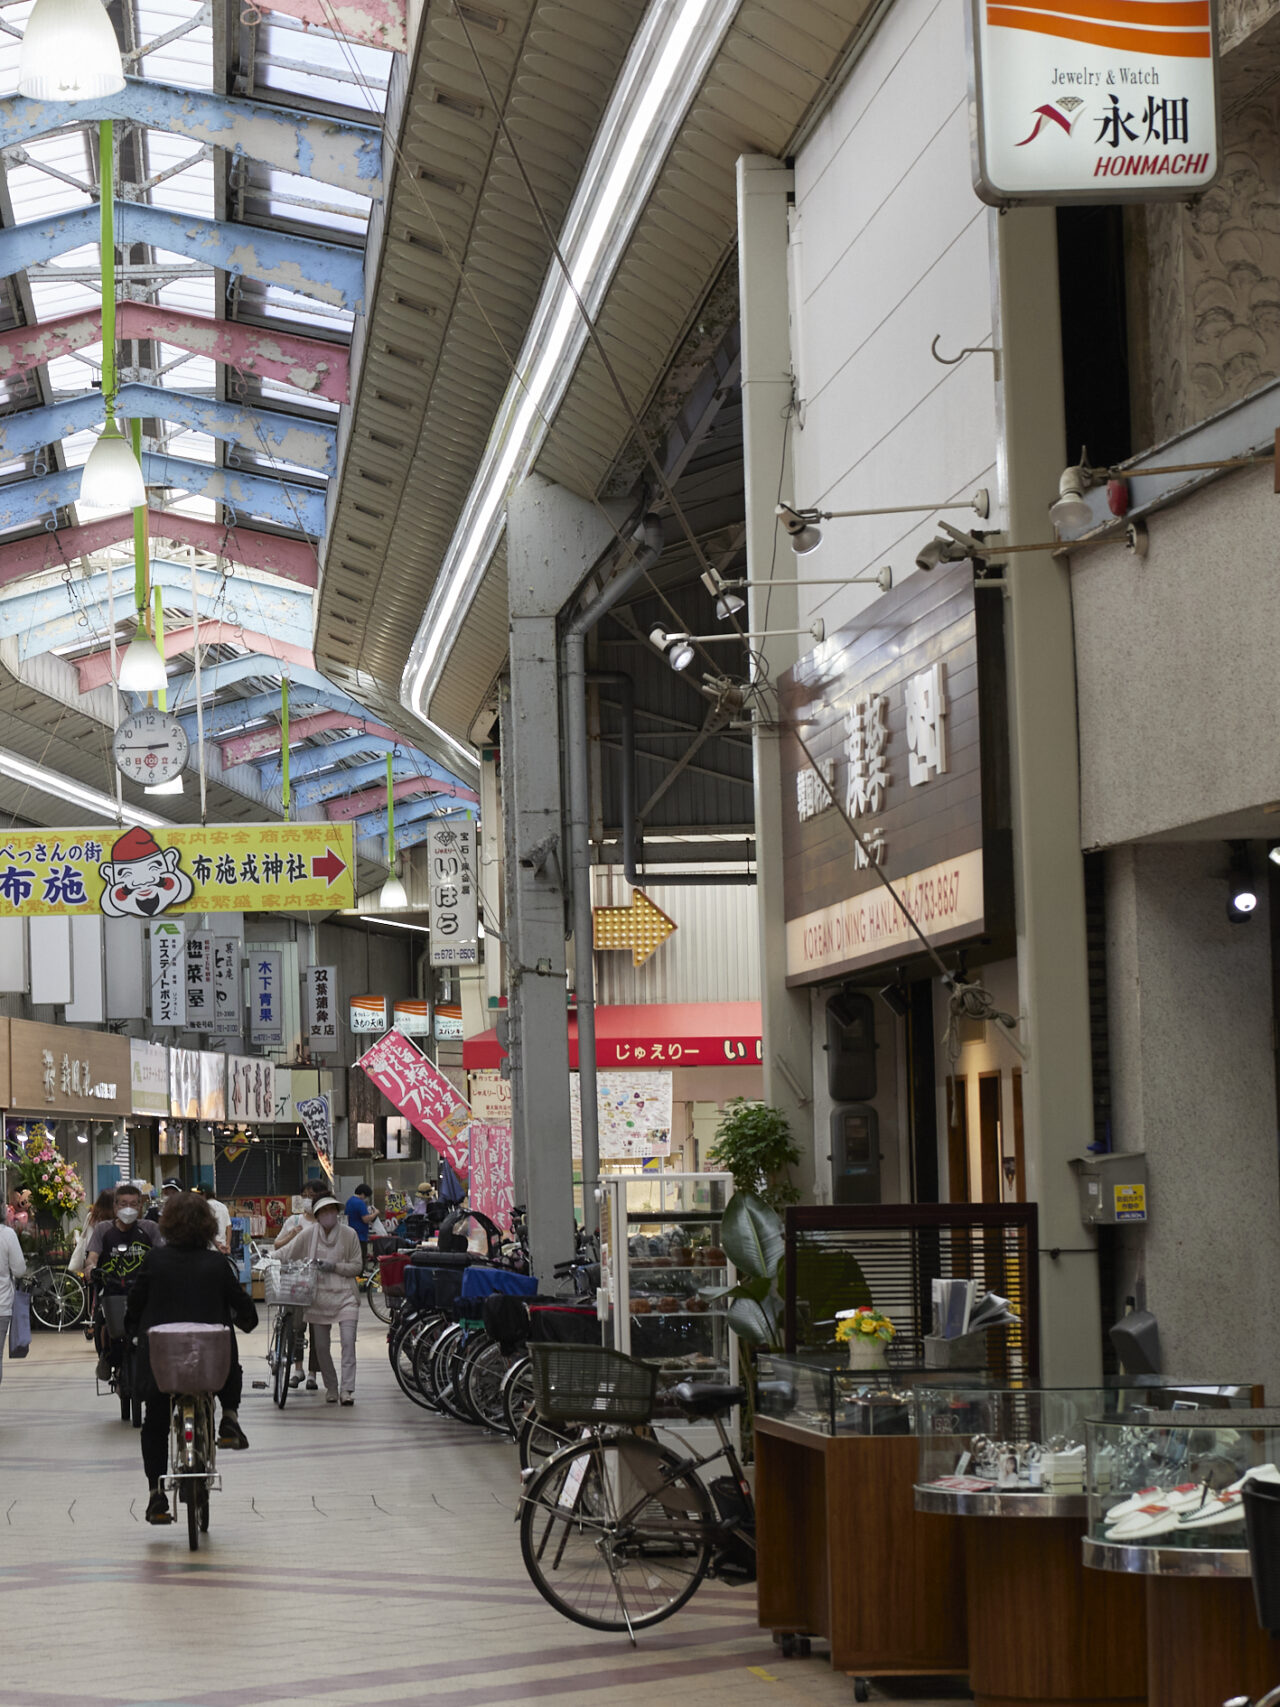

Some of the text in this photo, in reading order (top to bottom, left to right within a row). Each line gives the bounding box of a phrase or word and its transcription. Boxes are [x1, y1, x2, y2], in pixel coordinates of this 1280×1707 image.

[1052, 67, 1159, 86] Jewelry & Watch
[1093, 94, 1189, 148] 永畑
[1093, 153, 1209, 177] HONMACHI
[191, 852, 308, 887] 布施戎神社
[434, 857, 459, 936] いはら
[804, 923, 836, 961] KOREAN
[836, 908, 867, 951] DINING
[869, 894, 900, 939] HANLA
[159, 938, 171, 1021] エステートボンズ
[258, 960, 273, 1022] 木下青果
[616, 1043, 700, 1060] じゅえりー
